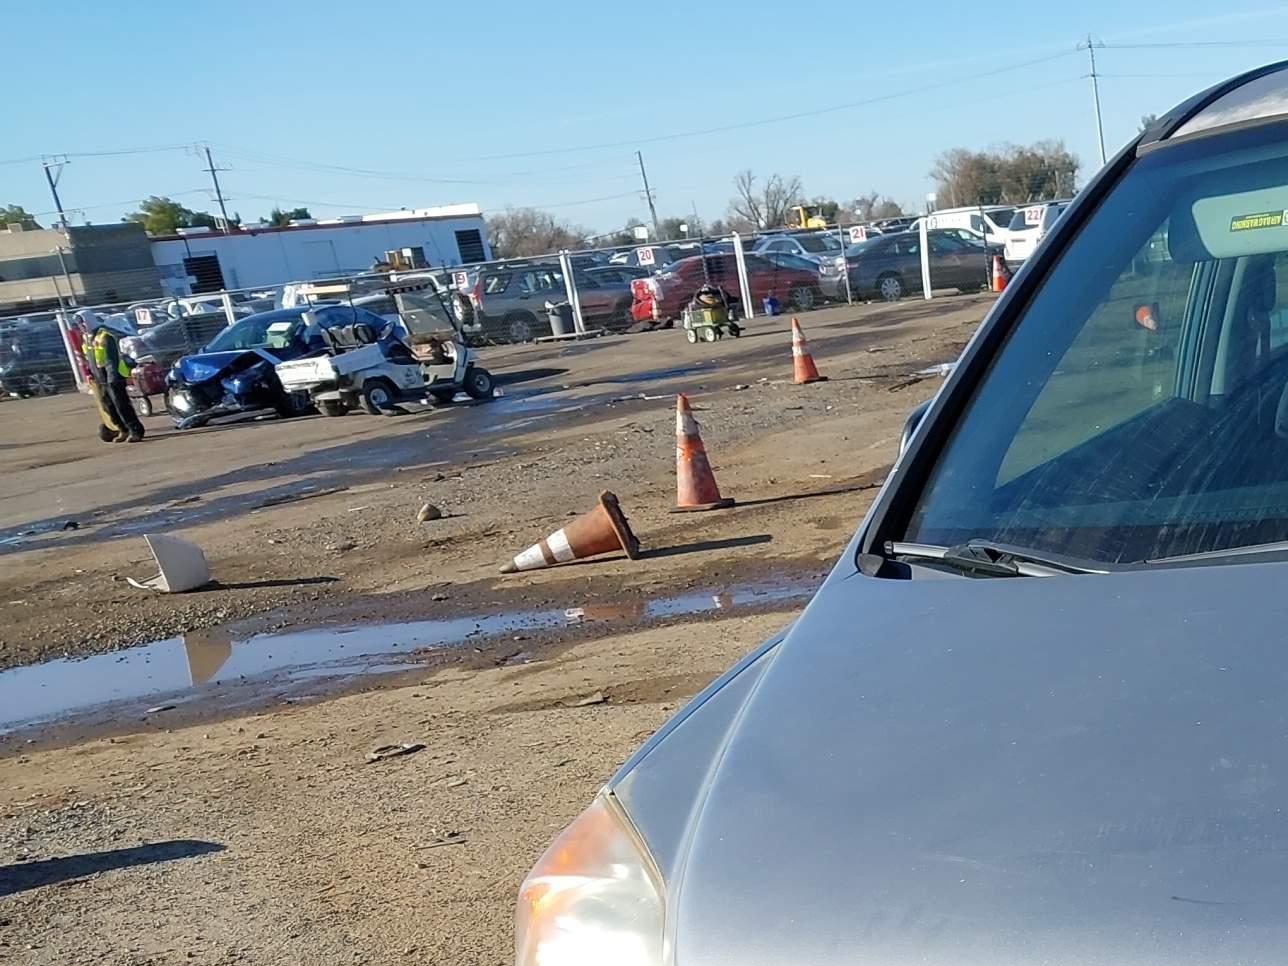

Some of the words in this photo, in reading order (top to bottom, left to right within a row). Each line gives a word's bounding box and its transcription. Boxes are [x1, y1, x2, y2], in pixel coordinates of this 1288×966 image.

[1027, 209, 1039, 221] 22
[851, 228, 864, 239] 21
[639, 249, 652, 262] 20
